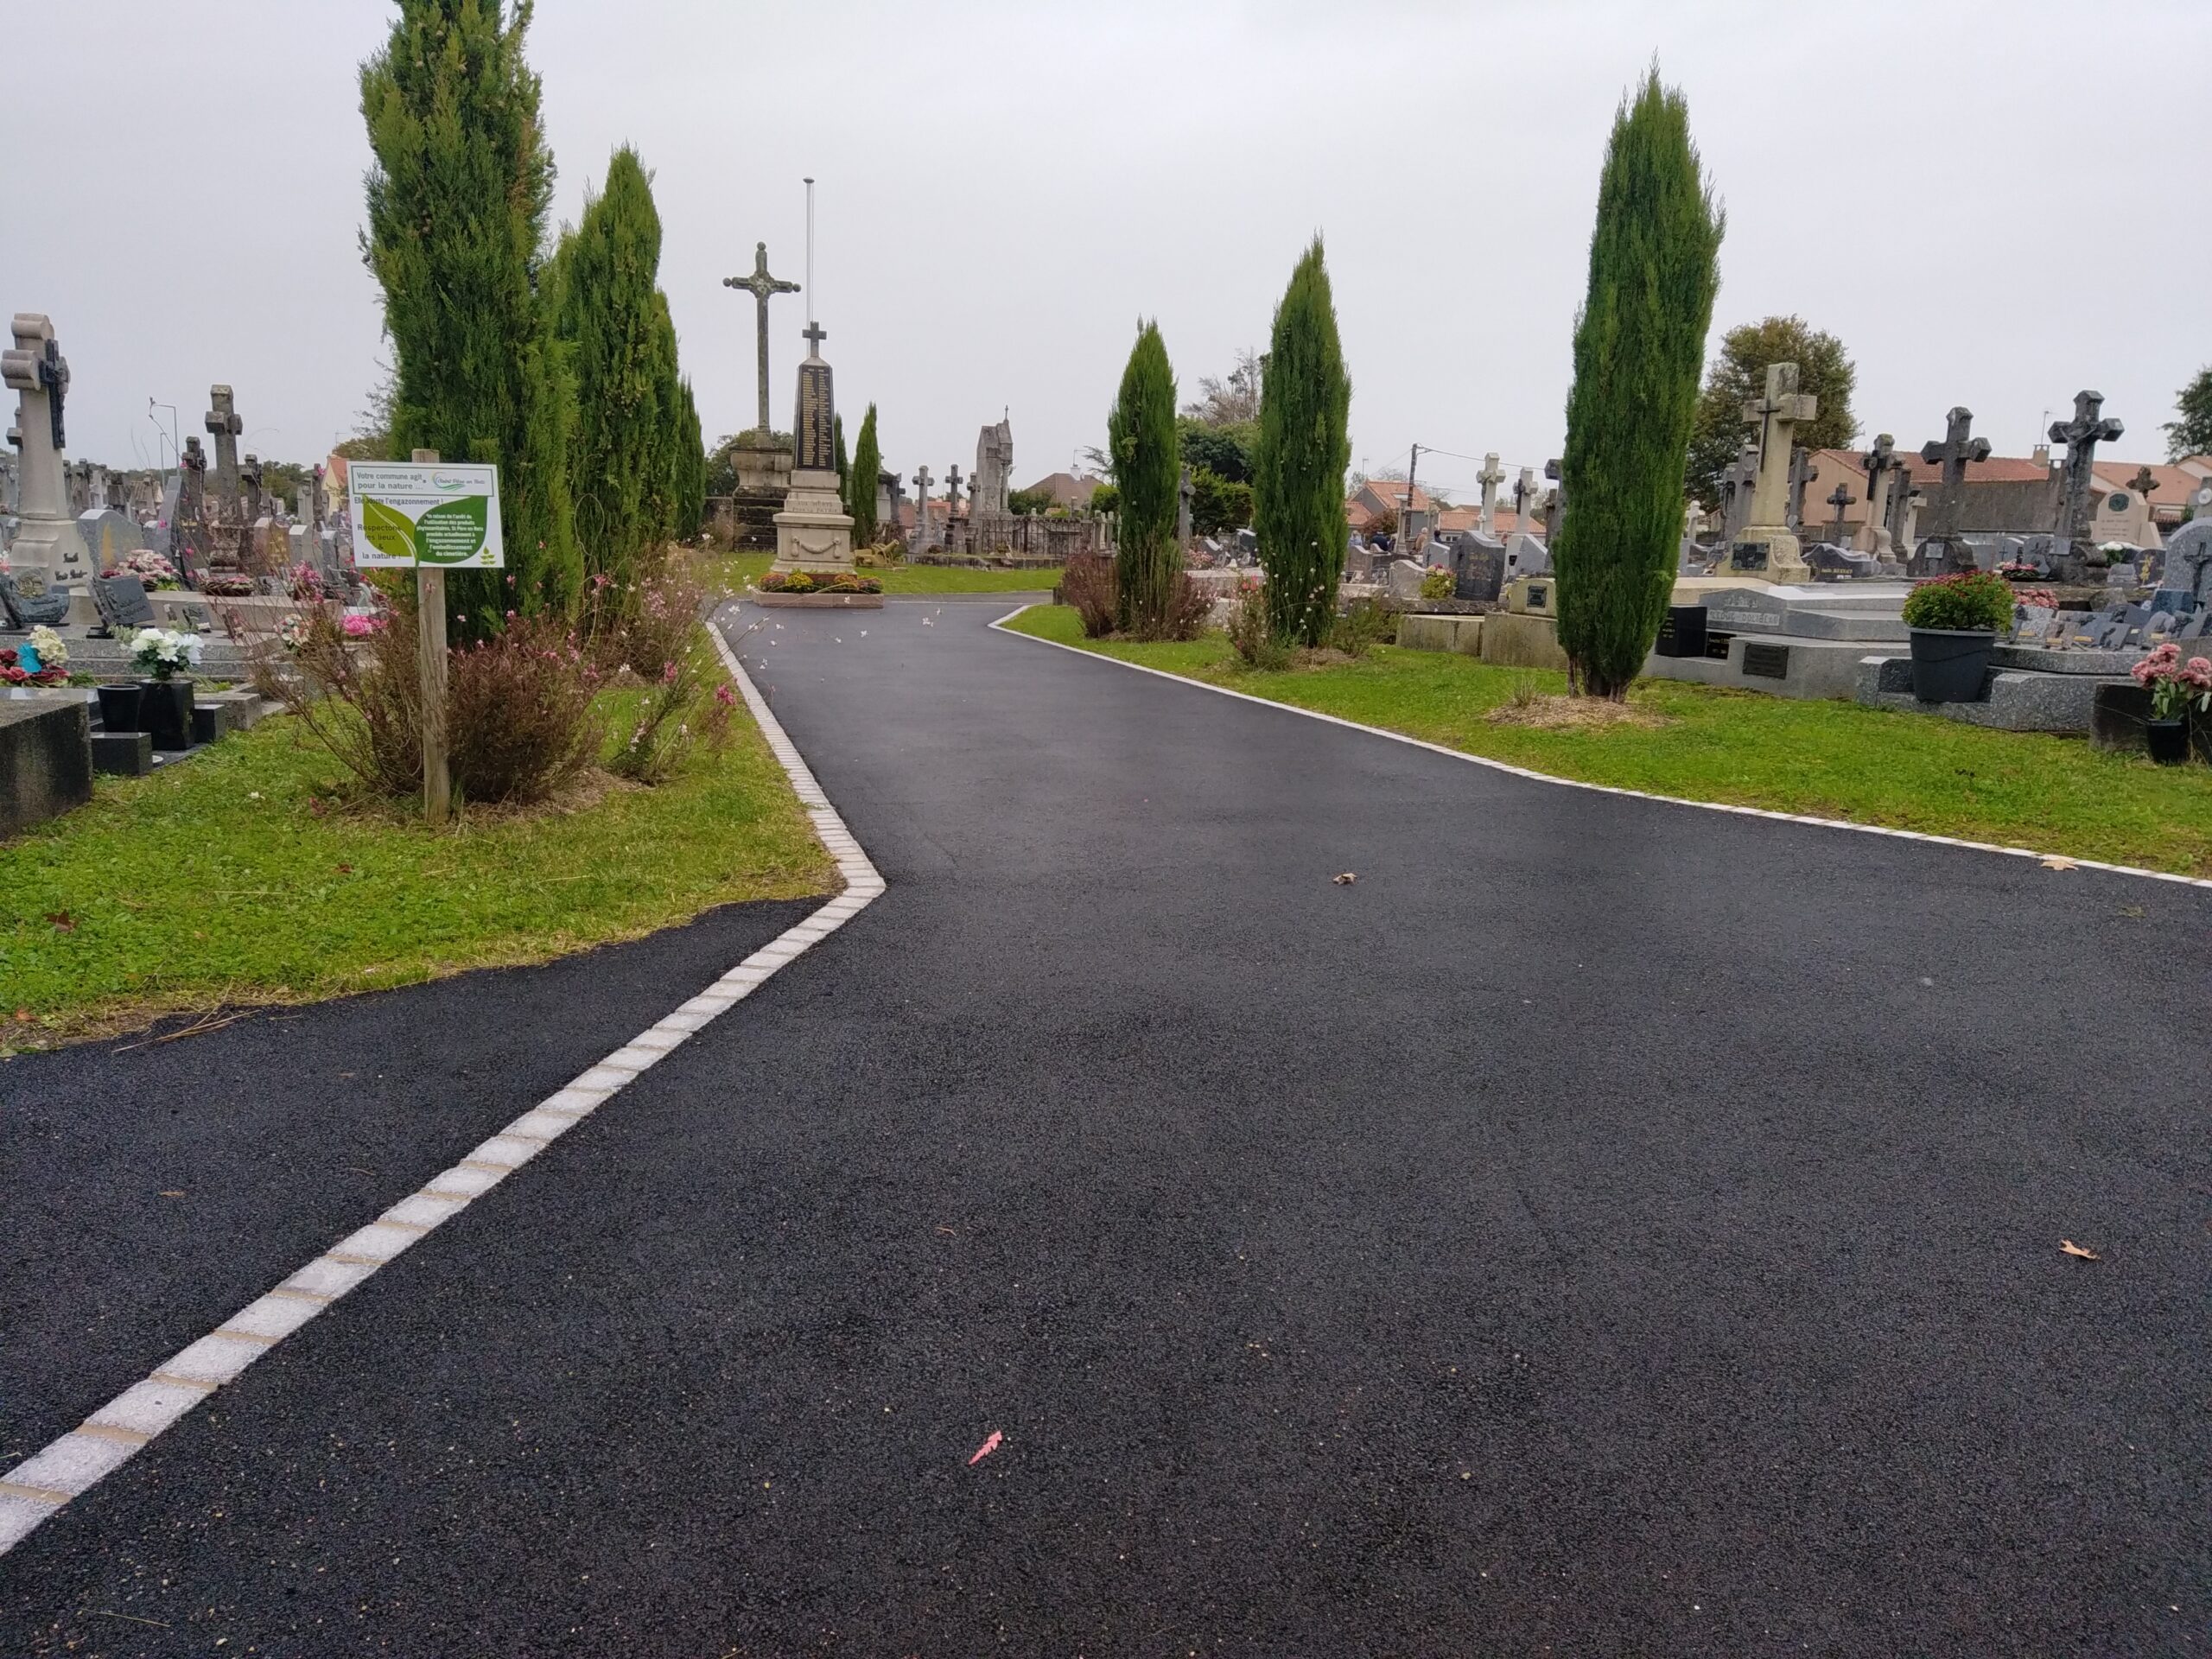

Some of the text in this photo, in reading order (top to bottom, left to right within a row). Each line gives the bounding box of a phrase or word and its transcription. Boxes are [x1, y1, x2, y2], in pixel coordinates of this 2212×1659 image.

[410, 473, 423, 481] agit
[385, 497, 440, 506] l'engazonnement
[357, 524, 401, 532] Respectons
